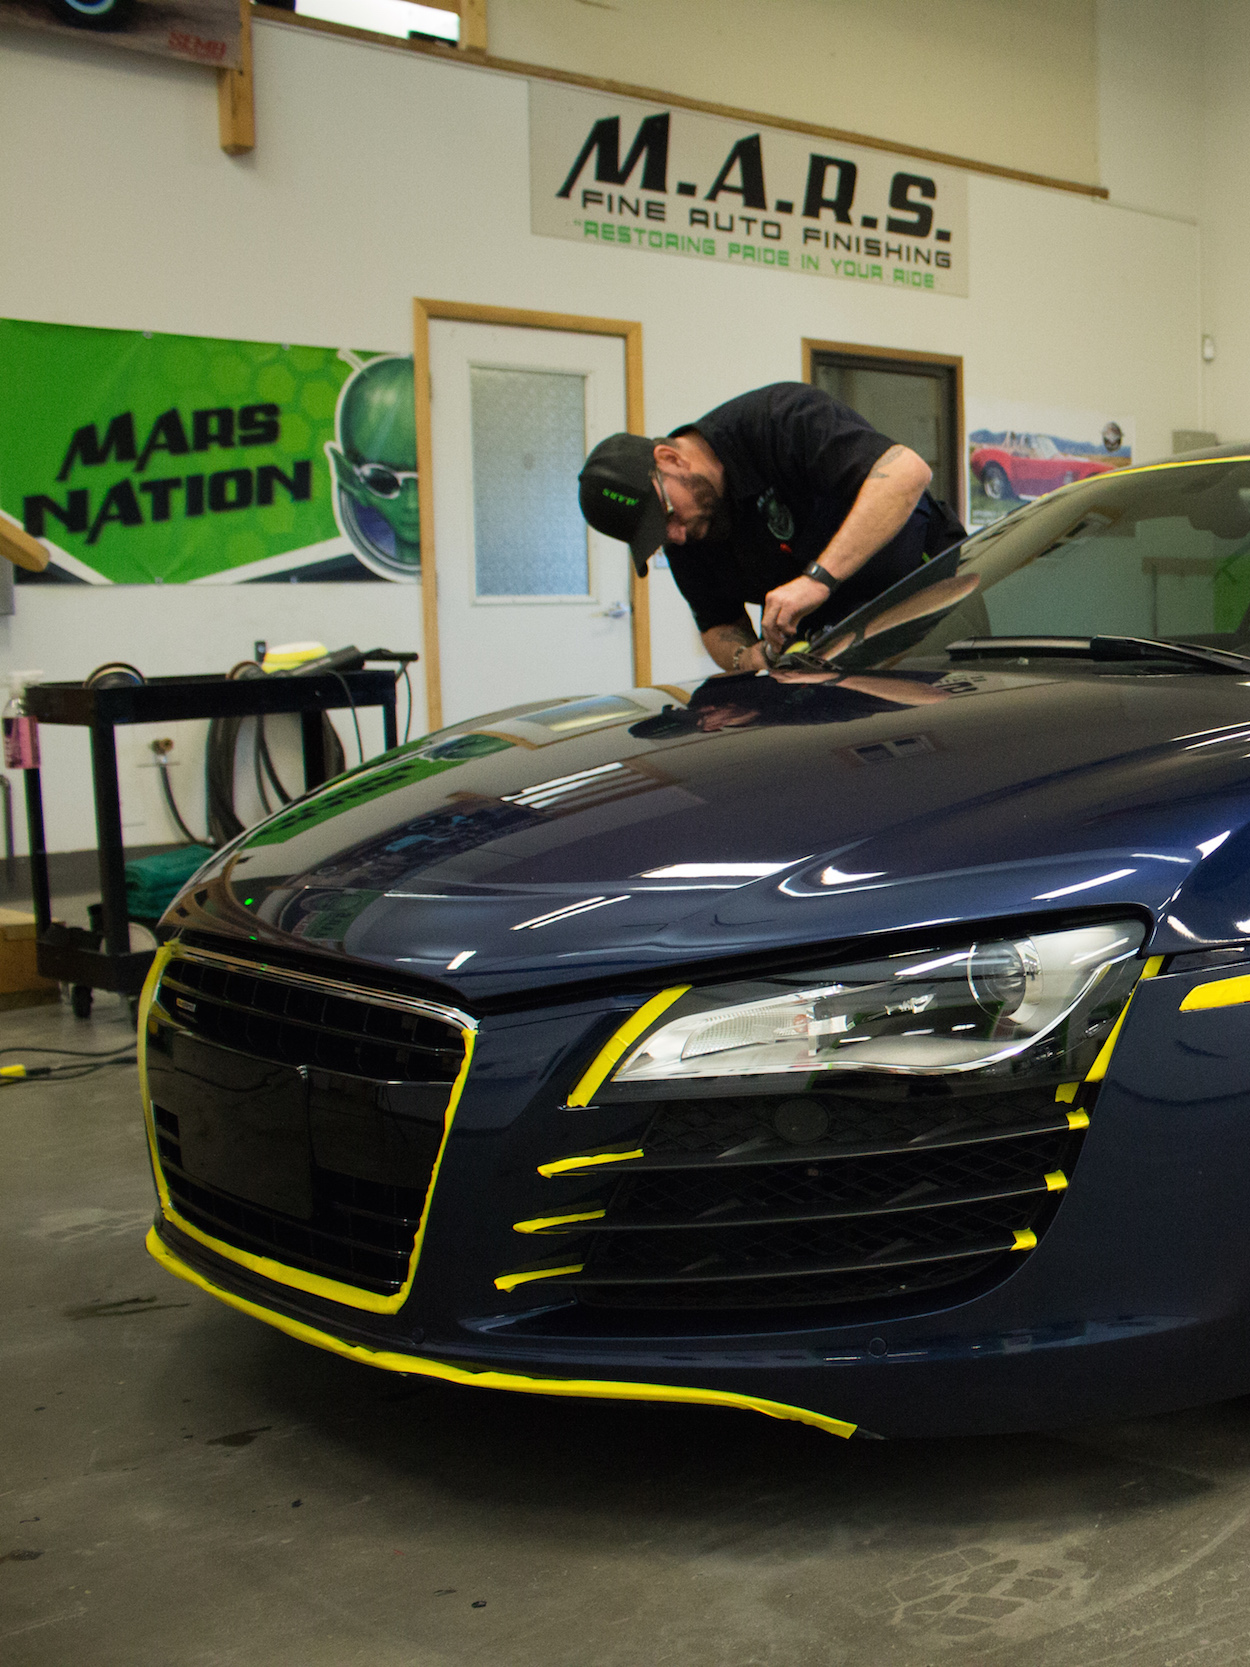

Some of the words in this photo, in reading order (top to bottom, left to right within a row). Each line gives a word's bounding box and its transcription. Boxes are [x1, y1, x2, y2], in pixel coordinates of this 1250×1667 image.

[555, 111, 952, 243] M.A.R.S.
[581, 189, 667, 222] FINE
[689, 207, 781, 241] AUTO
[803, 227, 951, 269] FINISHING
[728, 241, 790, 267] PRIDE
[801, 253, 820, 271] IN
[831, 258, 882, 280] YOUR
[893, 267, 935, 289] RIDE
[56, 403, 281, 482] MARS
[23, 460, 313, 545] NATION
